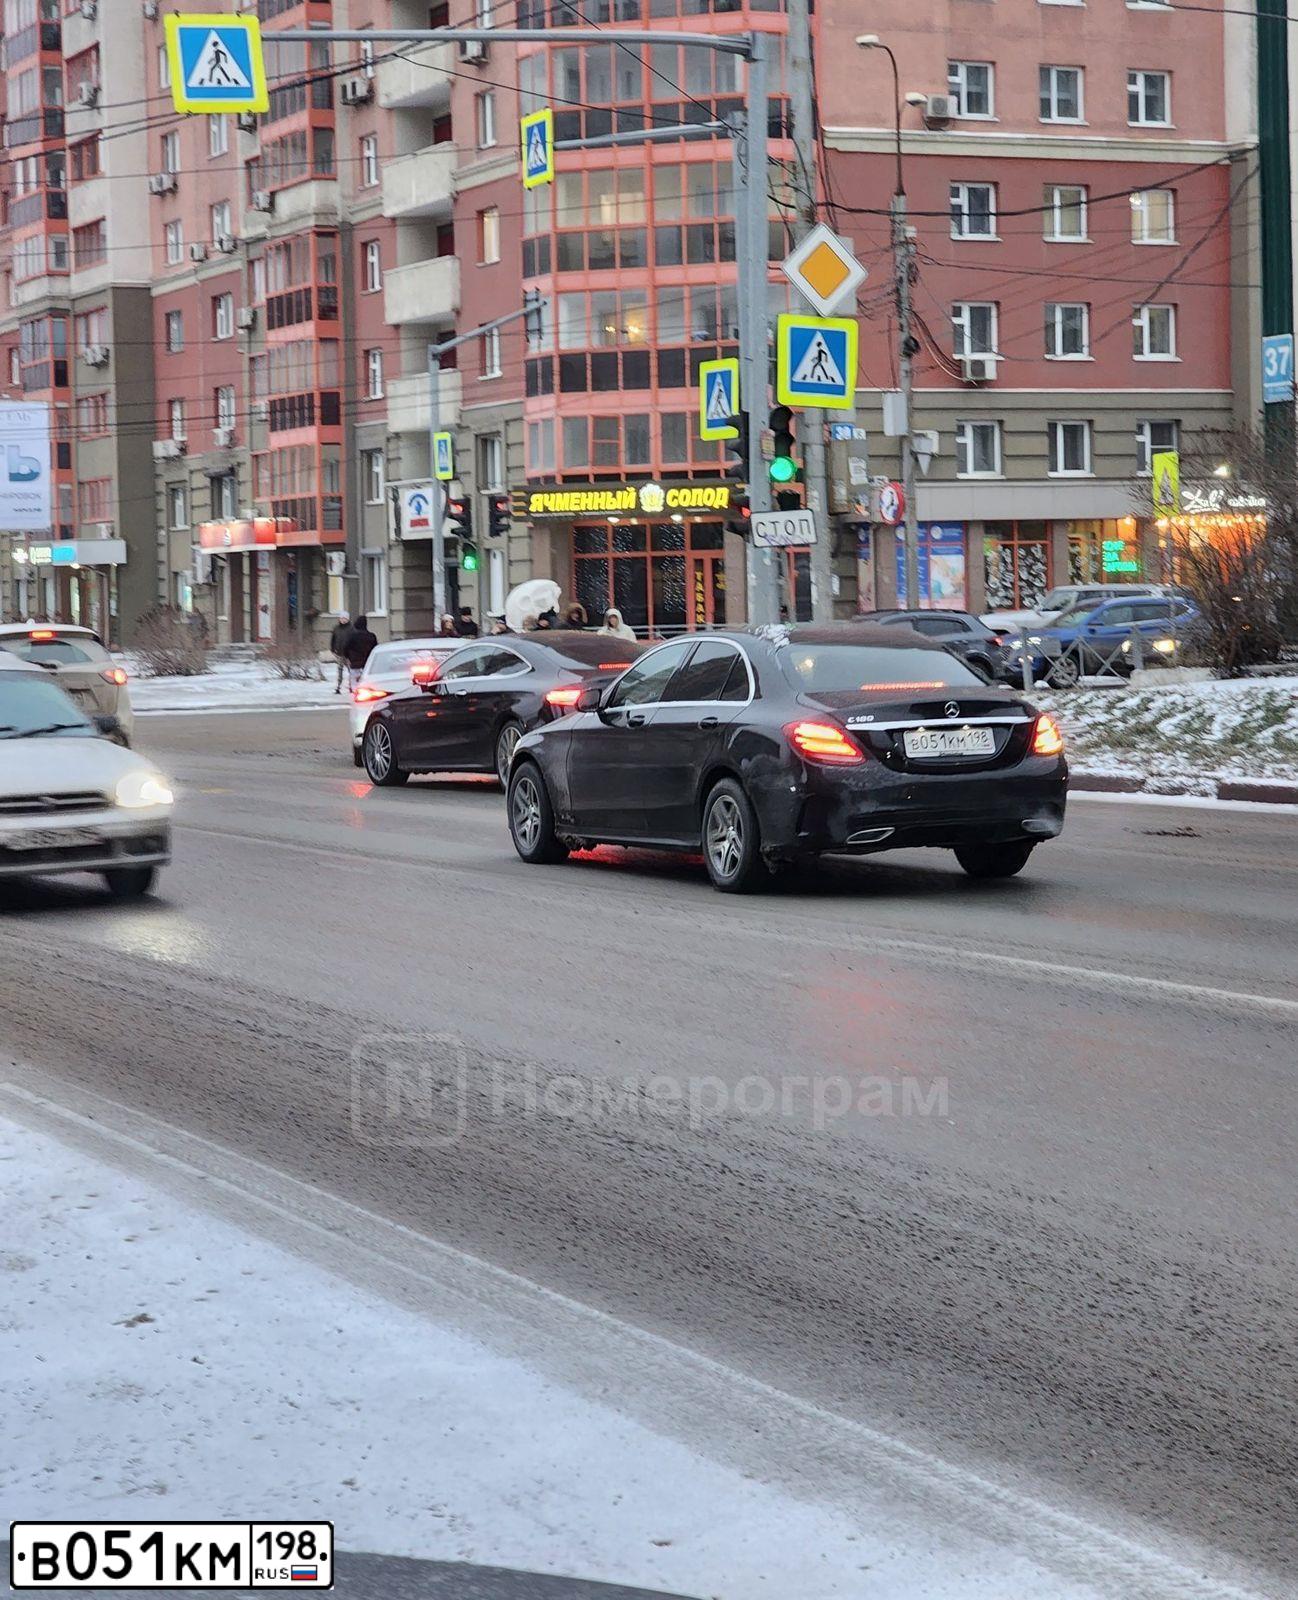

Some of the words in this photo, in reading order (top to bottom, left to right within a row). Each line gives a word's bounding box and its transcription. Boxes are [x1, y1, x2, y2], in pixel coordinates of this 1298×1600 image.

[1265, 346, 1290, 377] 37
[529, 486, 637, 512] ЯЧМЕННЫЙ
[755, 518, 812, 539] СТОП
